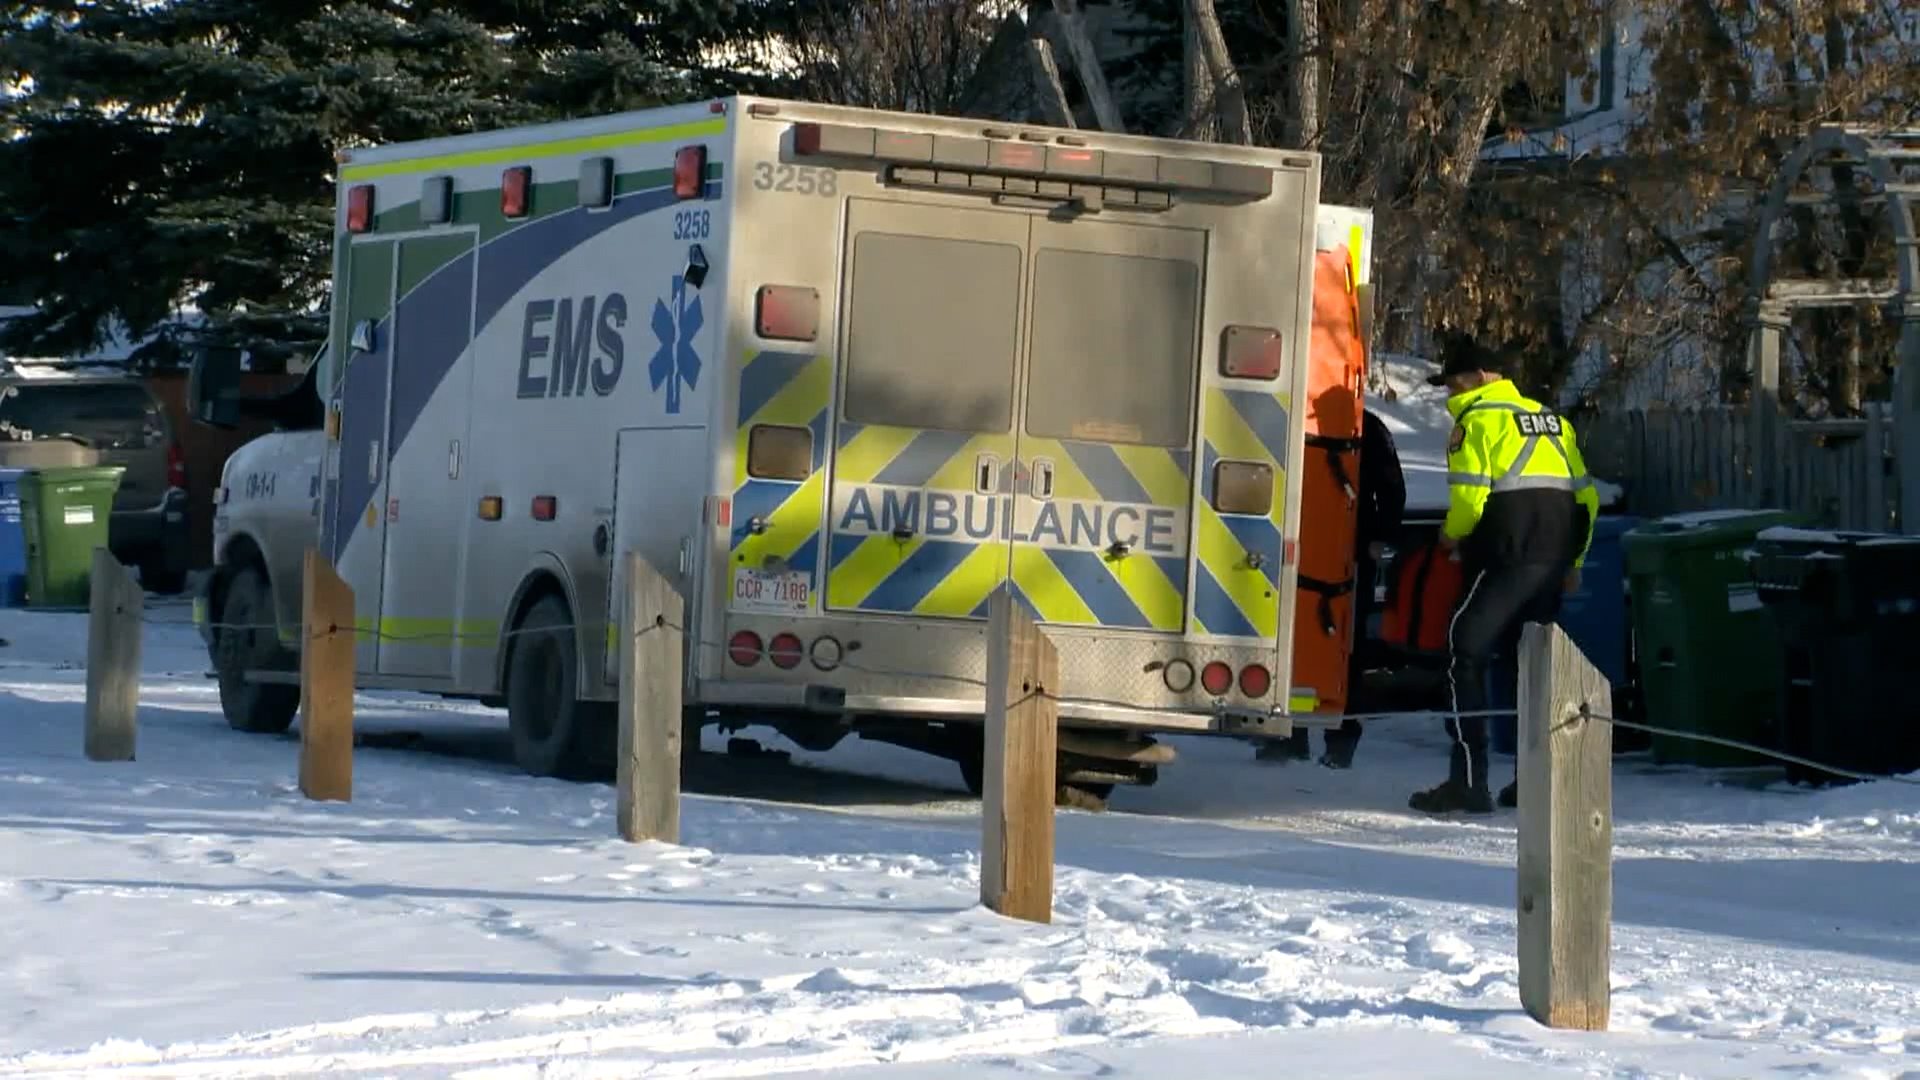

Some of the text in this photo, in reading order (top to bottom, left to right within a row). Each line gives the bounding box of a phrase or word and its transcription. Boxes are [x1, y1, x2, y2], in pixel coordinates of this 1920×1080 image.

[753, 161, 838, 198] 3258
[674, 209, 710, 240] 3258
[517, 292, 627, 399] EMS
[1520, 414, 1560, 433] EMS
[840, 487, 1175, 552] AMBULANCE
